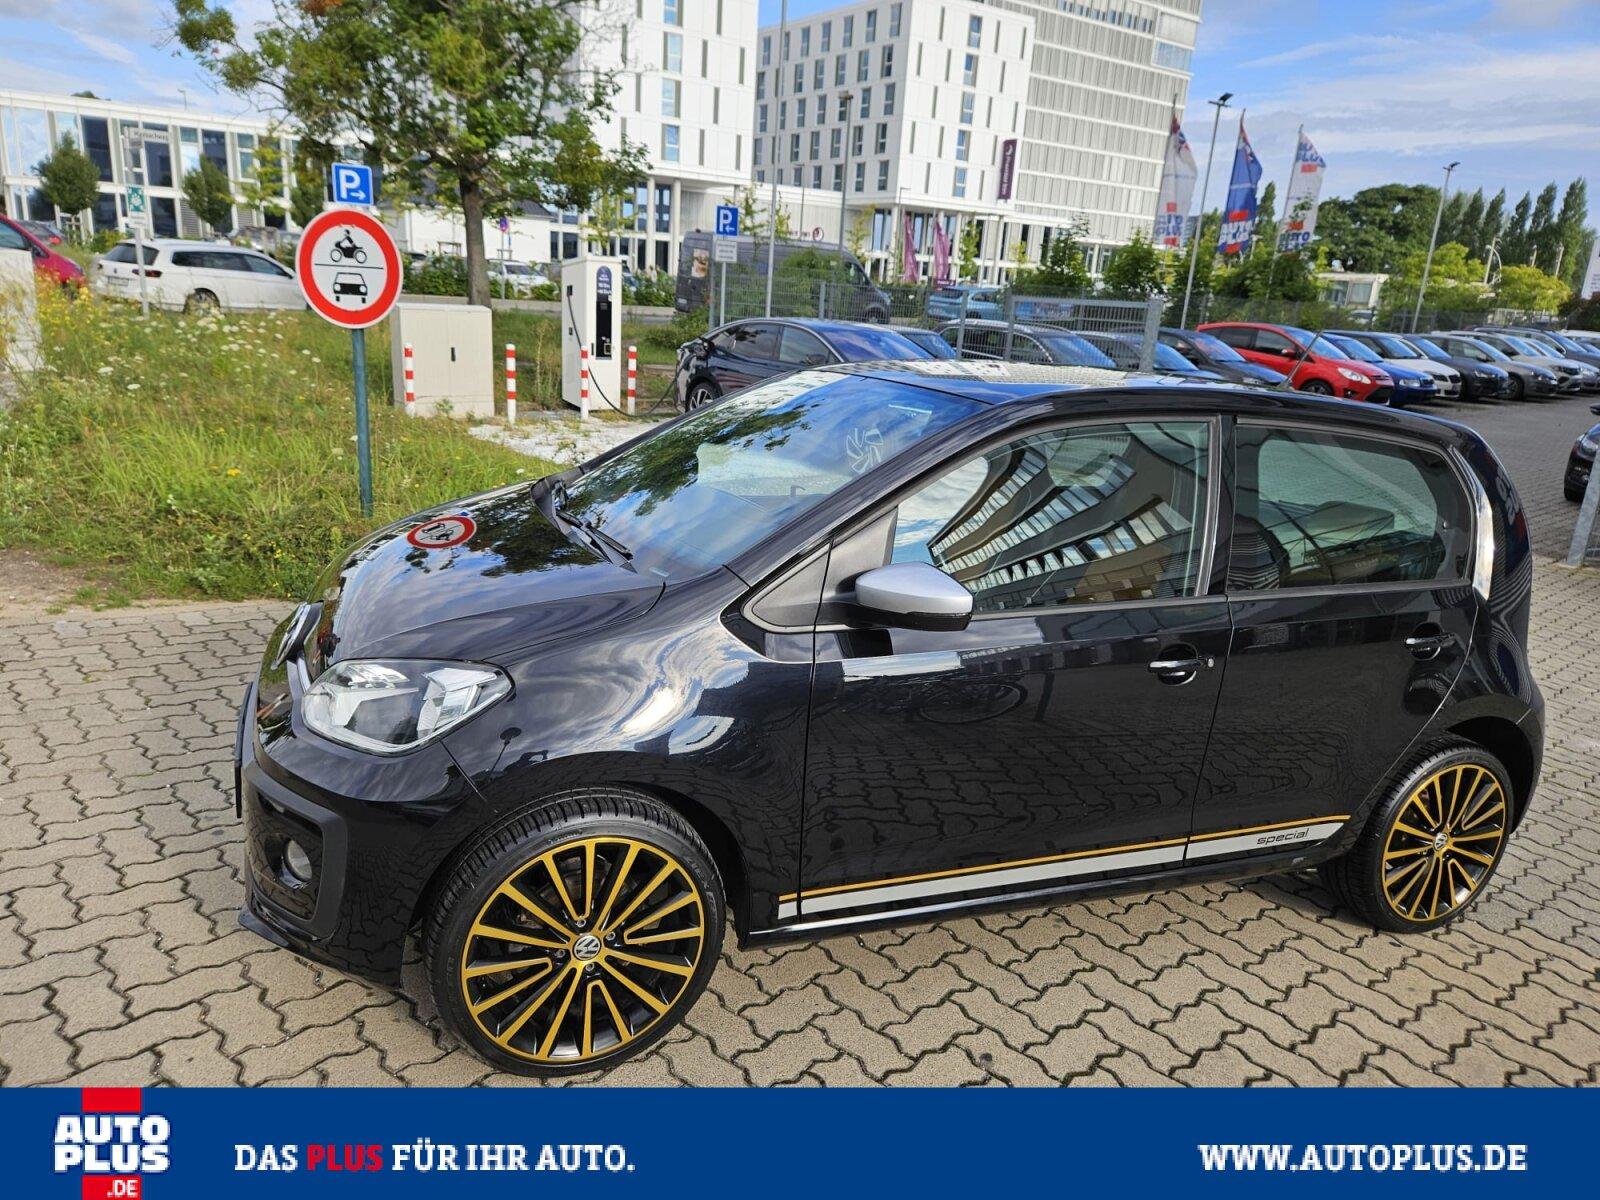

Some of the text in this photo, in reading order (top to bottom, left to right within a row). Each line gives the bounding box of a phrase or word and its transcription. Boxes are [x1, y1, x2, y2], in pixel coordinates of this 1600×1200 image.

[339, 169, 361, 200] P
[719, 208, 733, 232] P
[1257, 828, 1309, 845] special
